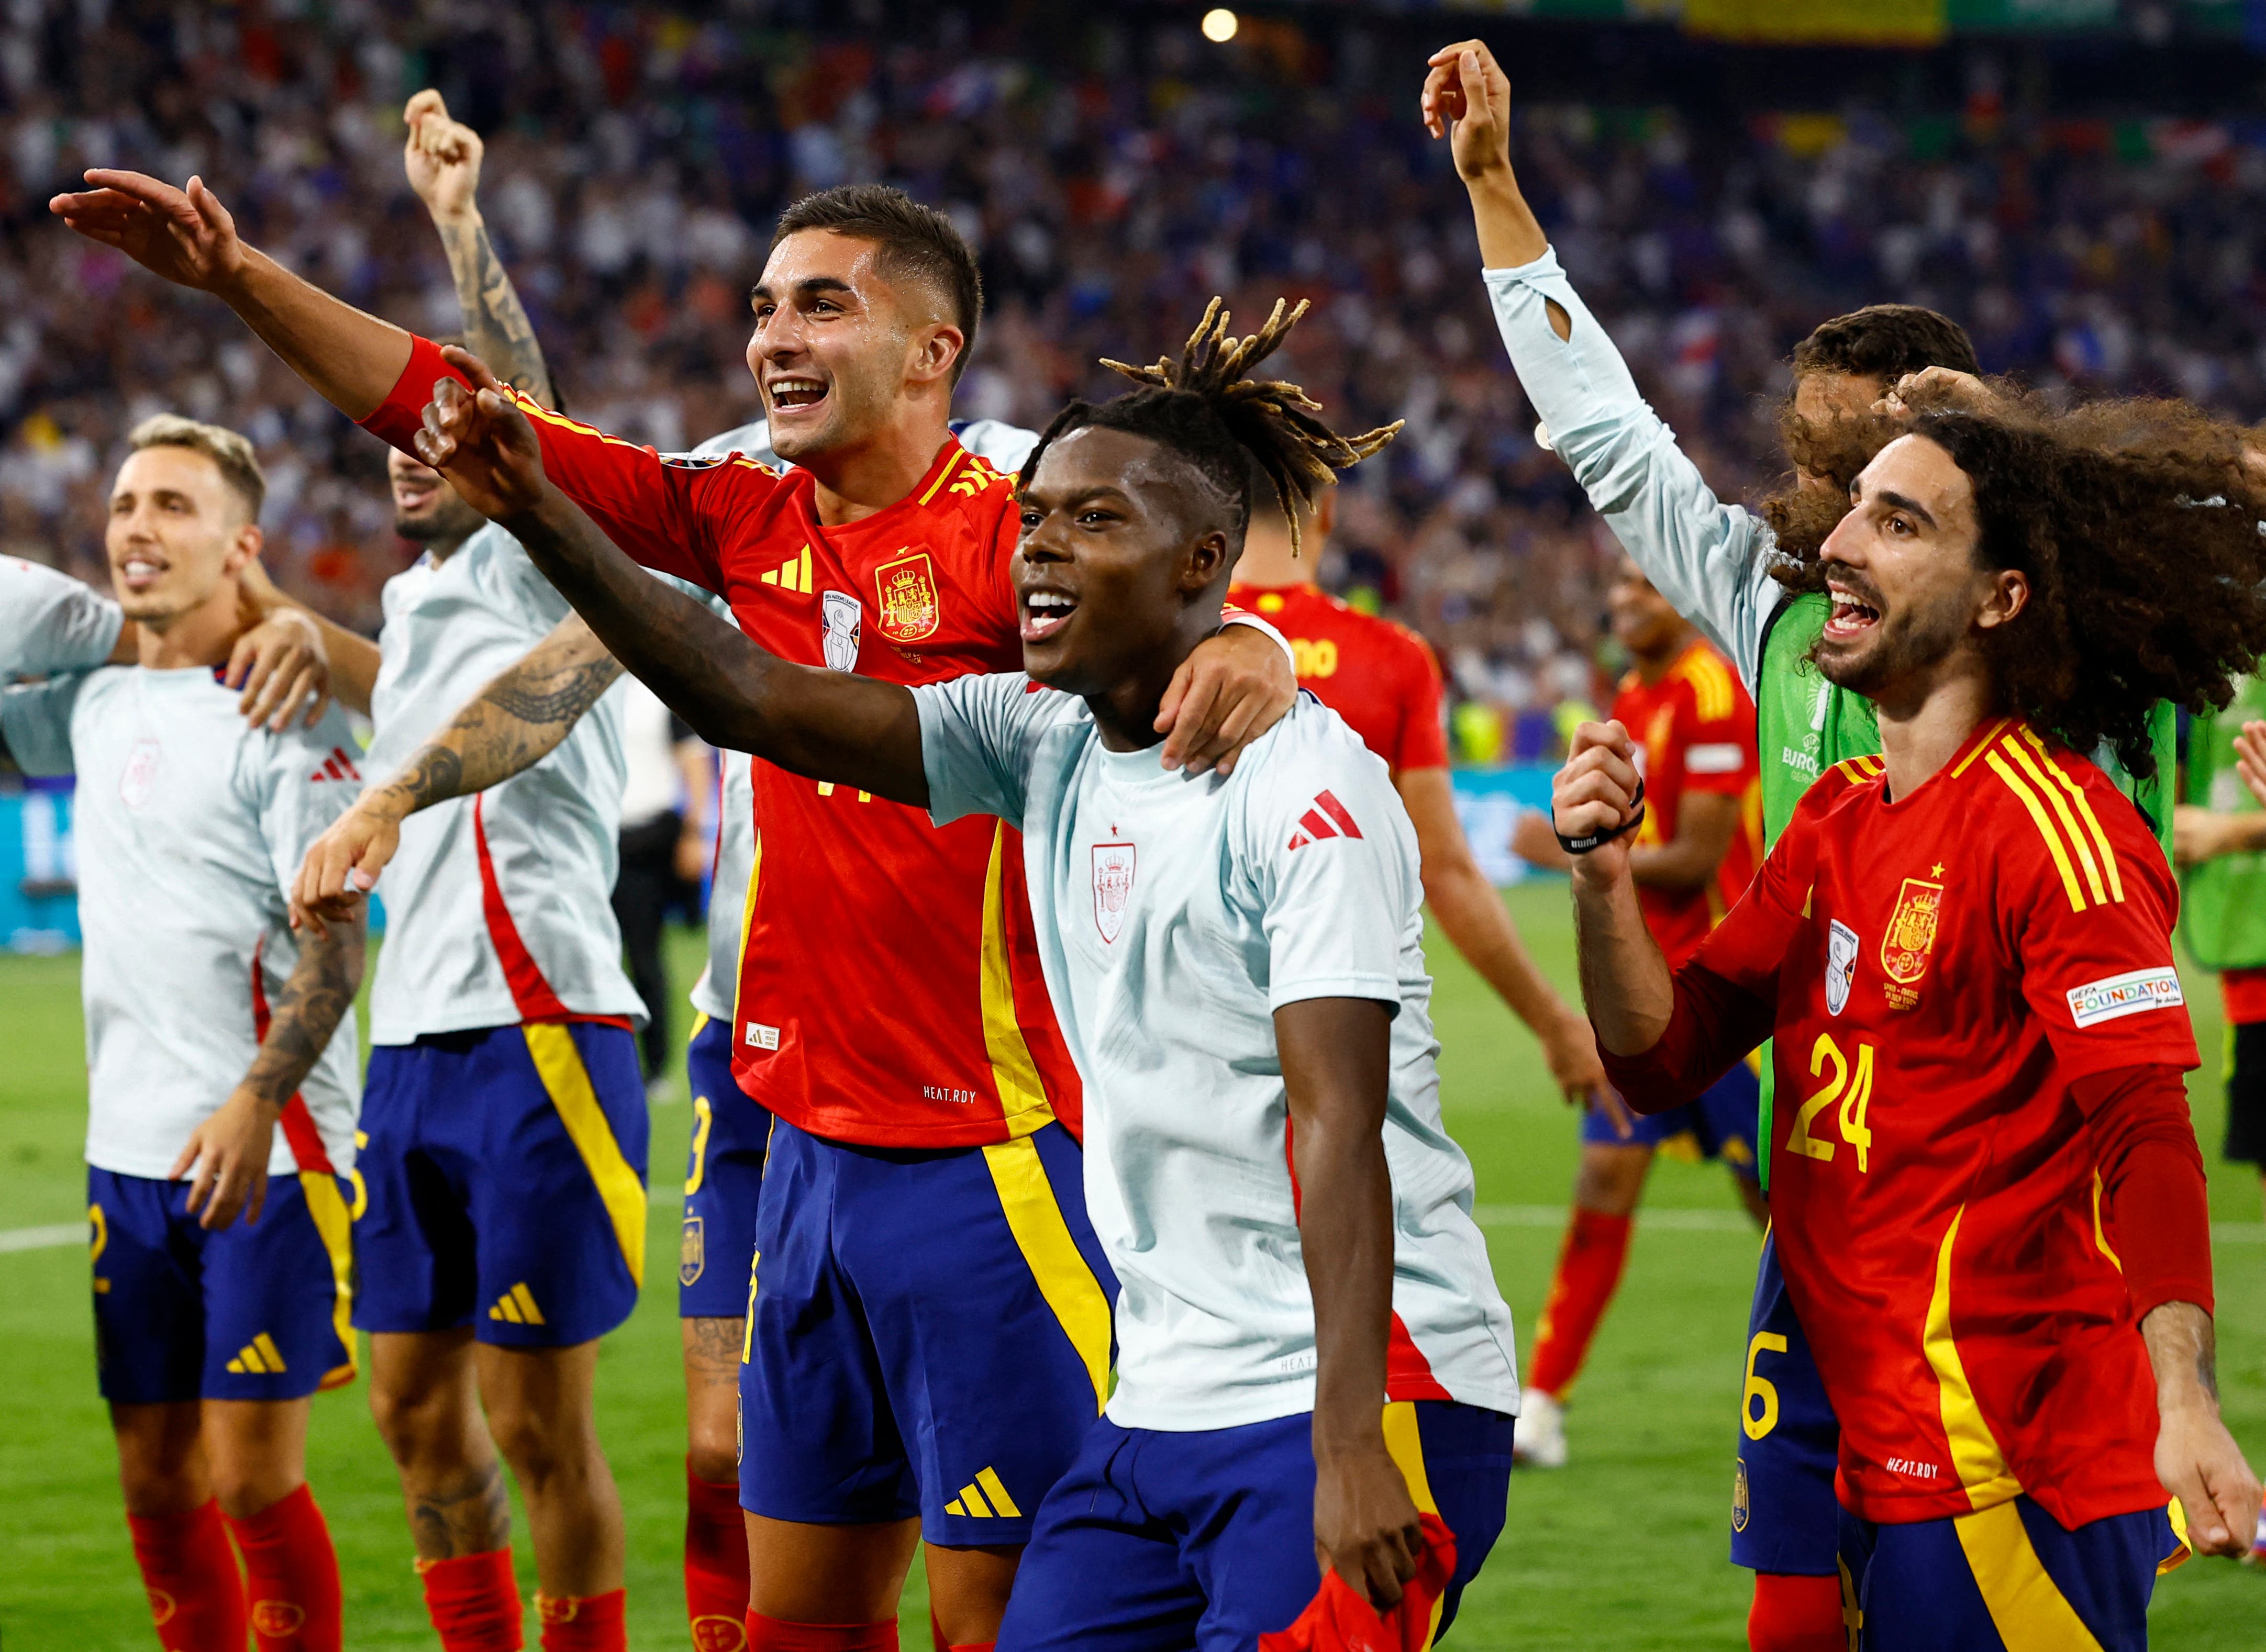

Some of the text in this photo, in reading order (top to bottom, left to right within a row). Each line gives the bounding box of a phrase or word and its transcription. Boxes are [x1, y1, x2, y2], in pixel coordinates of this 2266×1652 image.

[2071, 987, 2097, 1001] UEFA
[2074, 979, 2178, 1014] FOUNDATION
[924, 1085, 976, 1104] HEAT.RDY
[1785, 1032, 1874, 1174] 24
[1741, 1330, 1787, 1441] 6
[1886, 1457, 1938, 1480] HEAT.RDY
